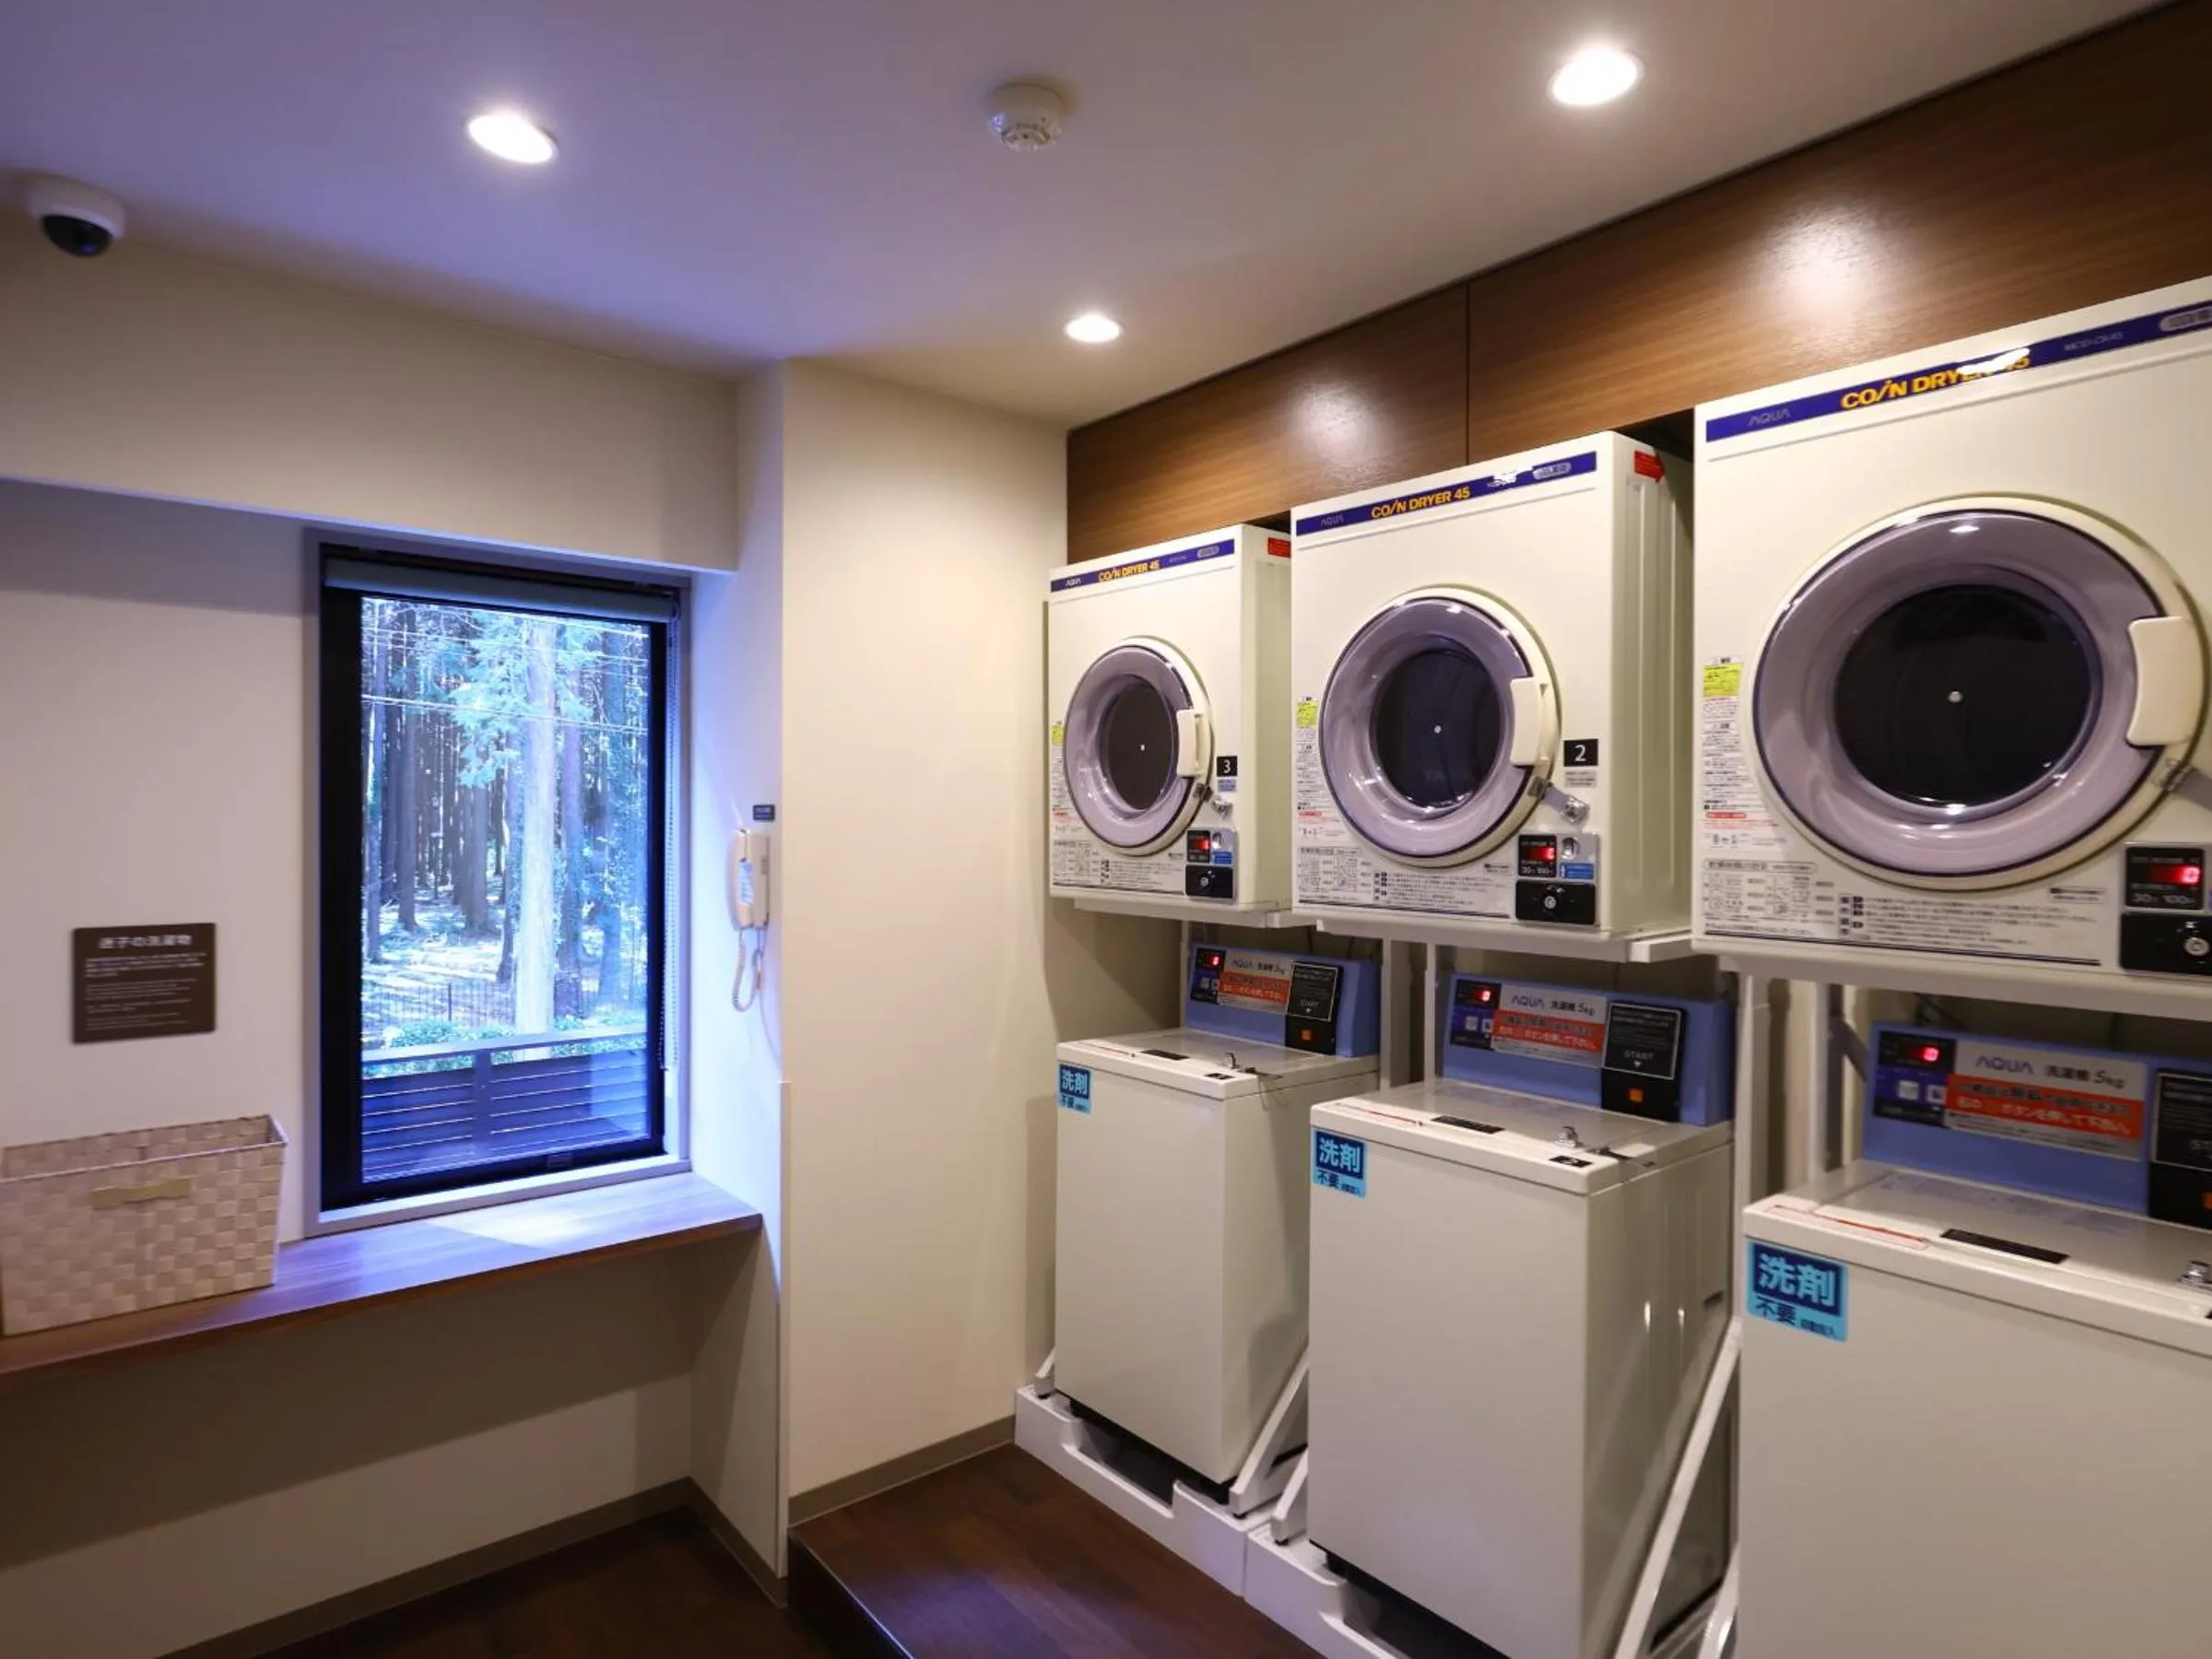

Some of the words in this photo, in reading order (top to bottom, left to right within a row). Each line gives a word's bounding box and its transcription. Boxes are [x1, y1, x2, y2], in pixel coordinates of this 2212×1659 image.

[1747, 407, 1791, 428] AQUA
[1912, 363, 1994, 394] DRY
[1320, 514, 1345, 526] AQUA
[1408, 492, 1452, 512] DRYER
[1453, 487, 1472, 500] 45
[1065, 577, 1082, 587] AQUA
[1122, 562, 1148, 578] DRYER
[1149, 559, 1159, 571] 45
[1223, 760, 1231, 774] 3
[1574, 744, 1586, 761] 2
[1512, 994, 1545, 1009] AQUA
[1062, 1068, 1088, 1094] 洗剤
[1975, 1055, 2035, 1076] AQUA
[2093, 1069, 2124, 1089] 5kg
[1319, 1136, 1360, 1173] 洗剤
[1316, 1170, 1339, 1190] 不要
[1759, 1253, 1836, 1307] 洗剤
[1755, 1295, 1797, 1326] 不要
